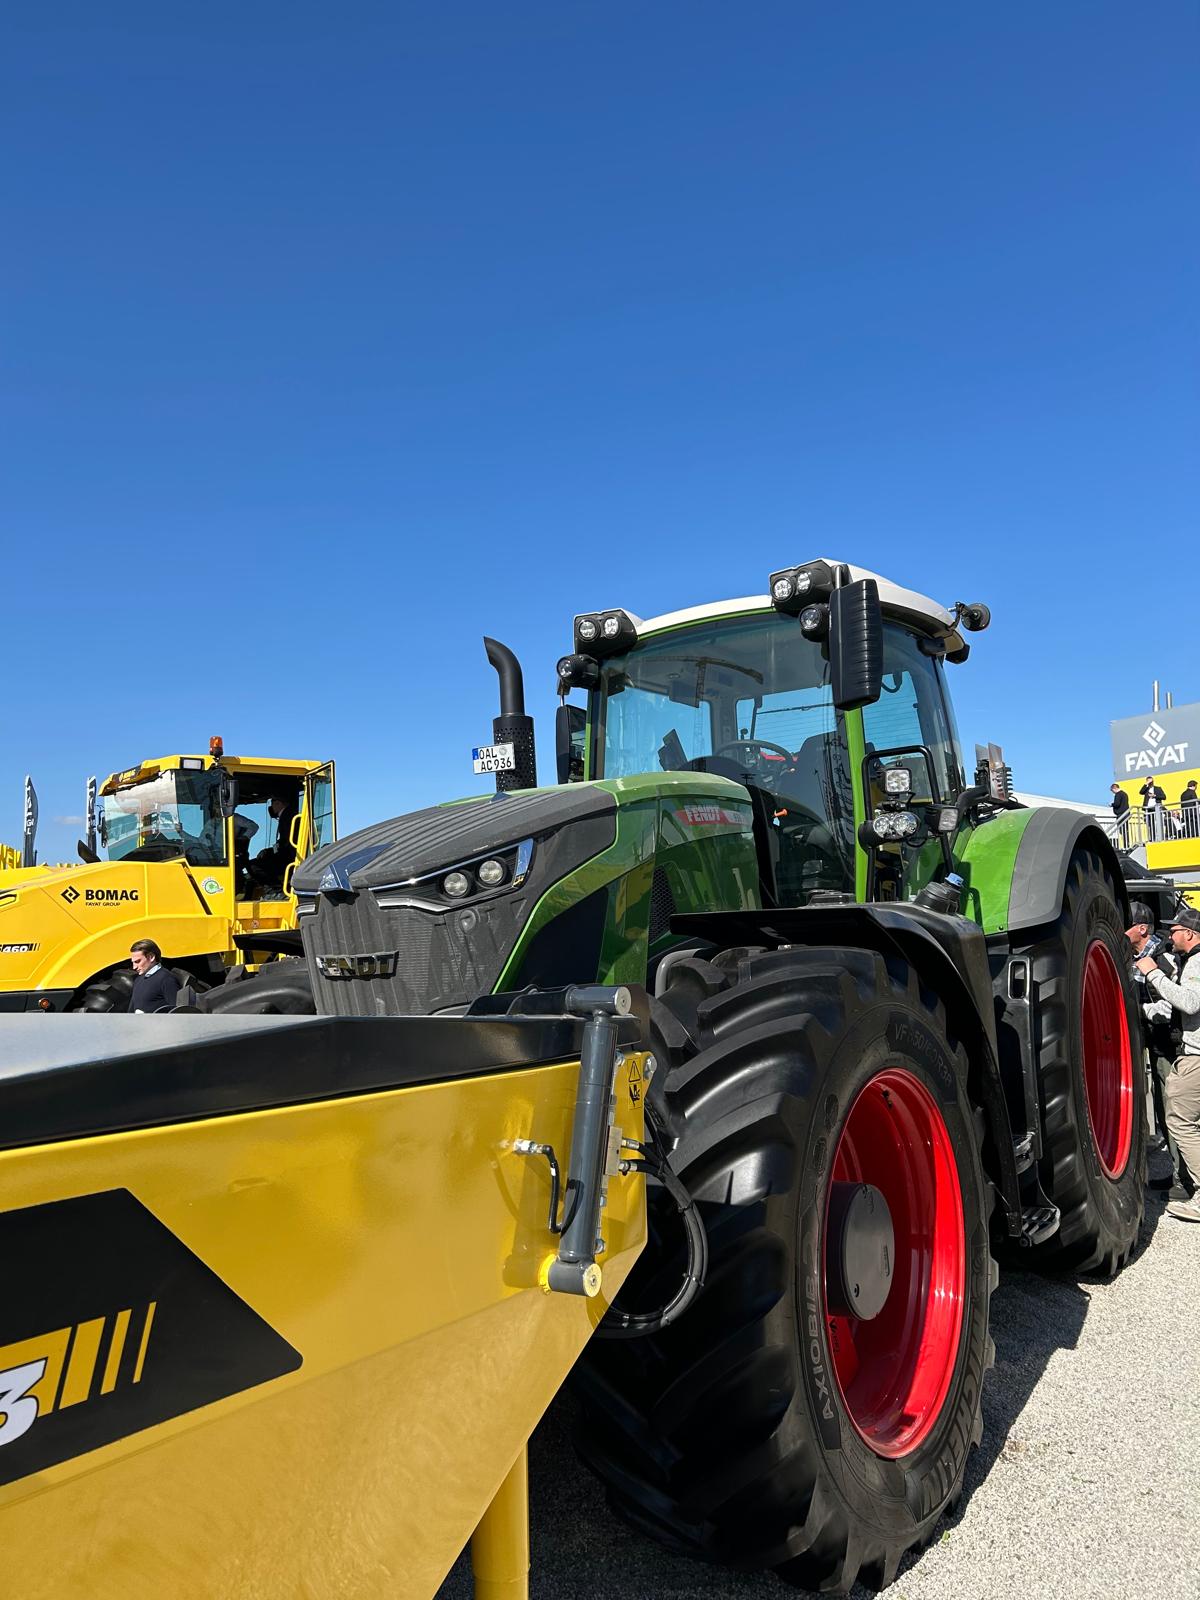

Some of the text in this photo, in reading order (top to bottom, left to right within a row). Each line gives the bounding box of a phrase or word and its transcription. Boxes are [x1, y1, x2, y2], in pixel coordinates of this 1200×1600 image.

[479, 747, 497, 760] OAL
[1125, 742, 1189, 772] FAYAT
[85, 889, 139, 901] BOMAG
[805, 1275, 835, 1420] AXIOBIB
